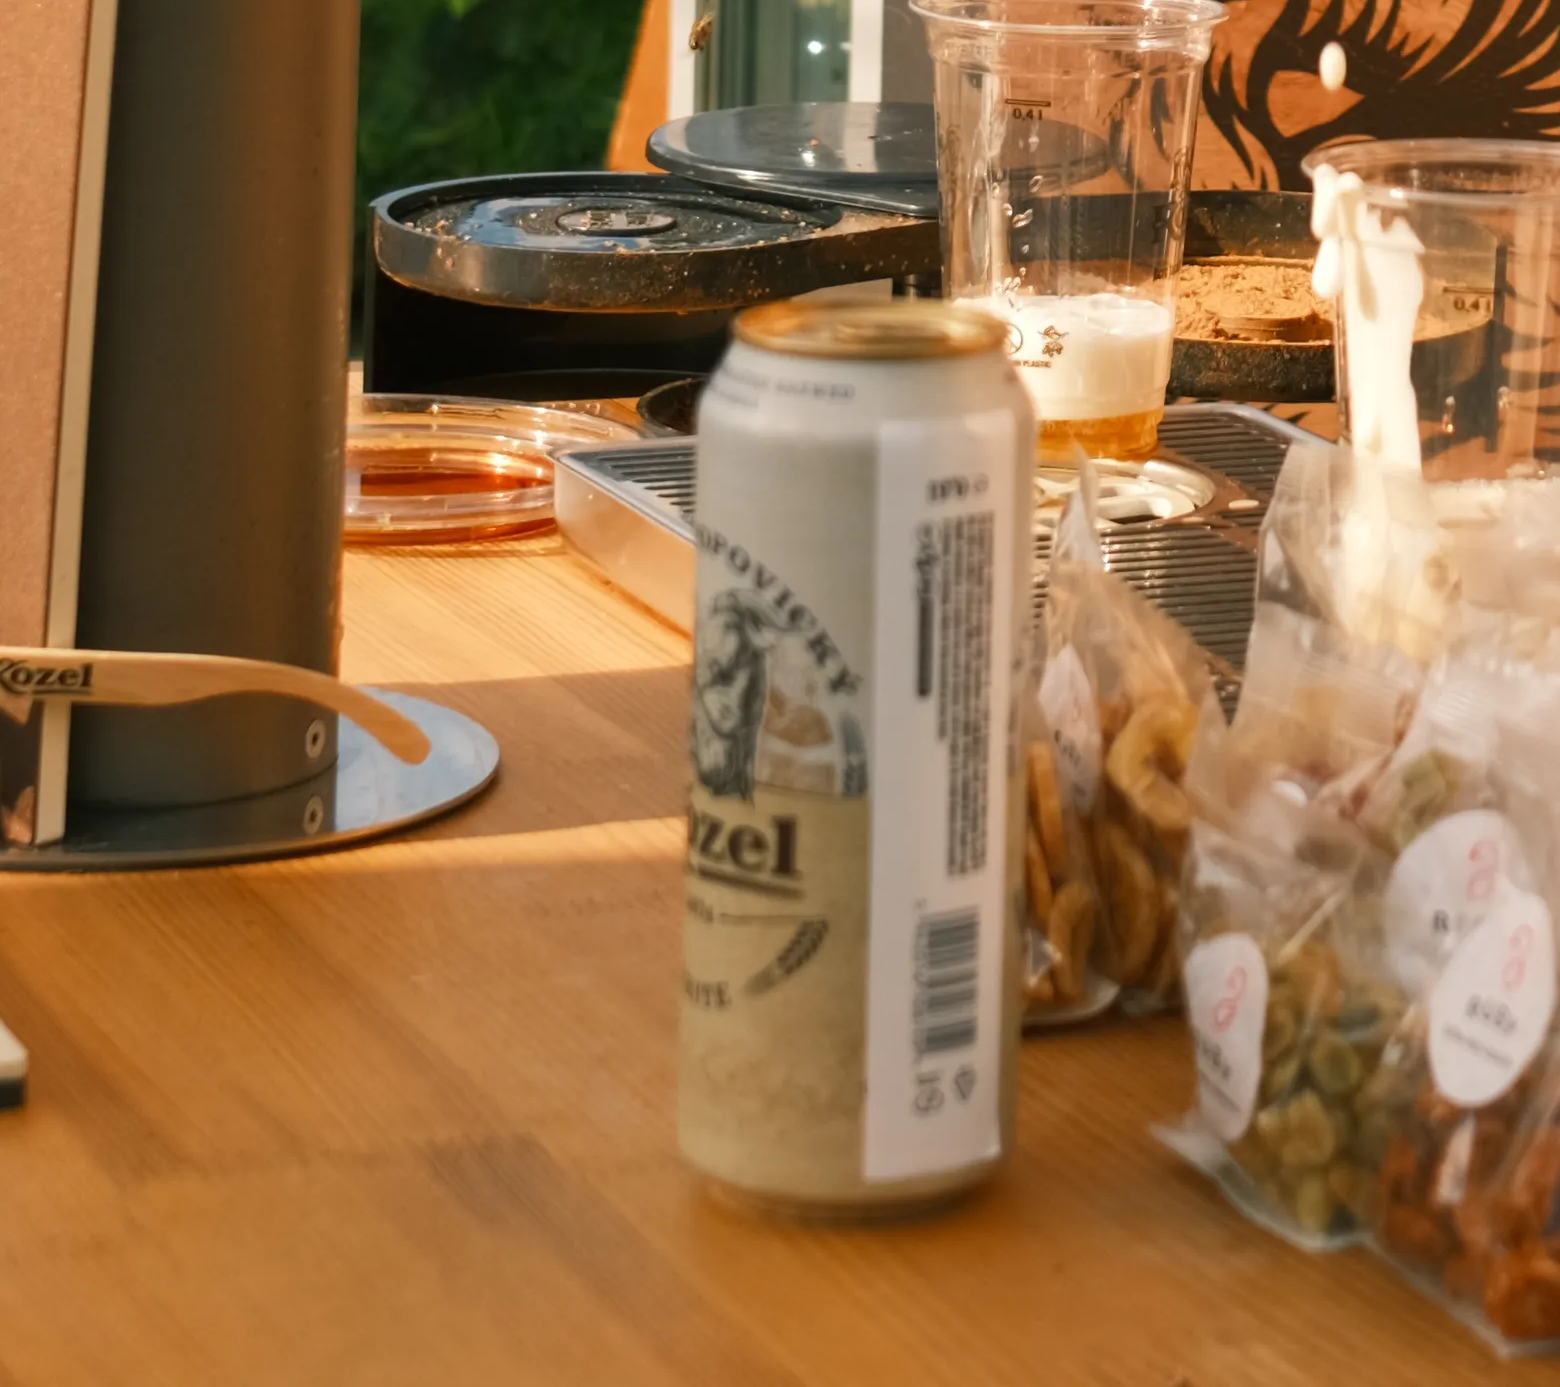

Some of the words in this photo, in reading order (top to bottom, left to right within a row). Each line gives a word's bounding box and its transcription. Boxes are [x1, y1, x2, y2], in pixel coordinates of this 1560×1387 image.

[1013, 107, 1034, 122] 0,4
[1453, 296, 1481, 314] 0,4
[690, 811, 804, 887] zel
